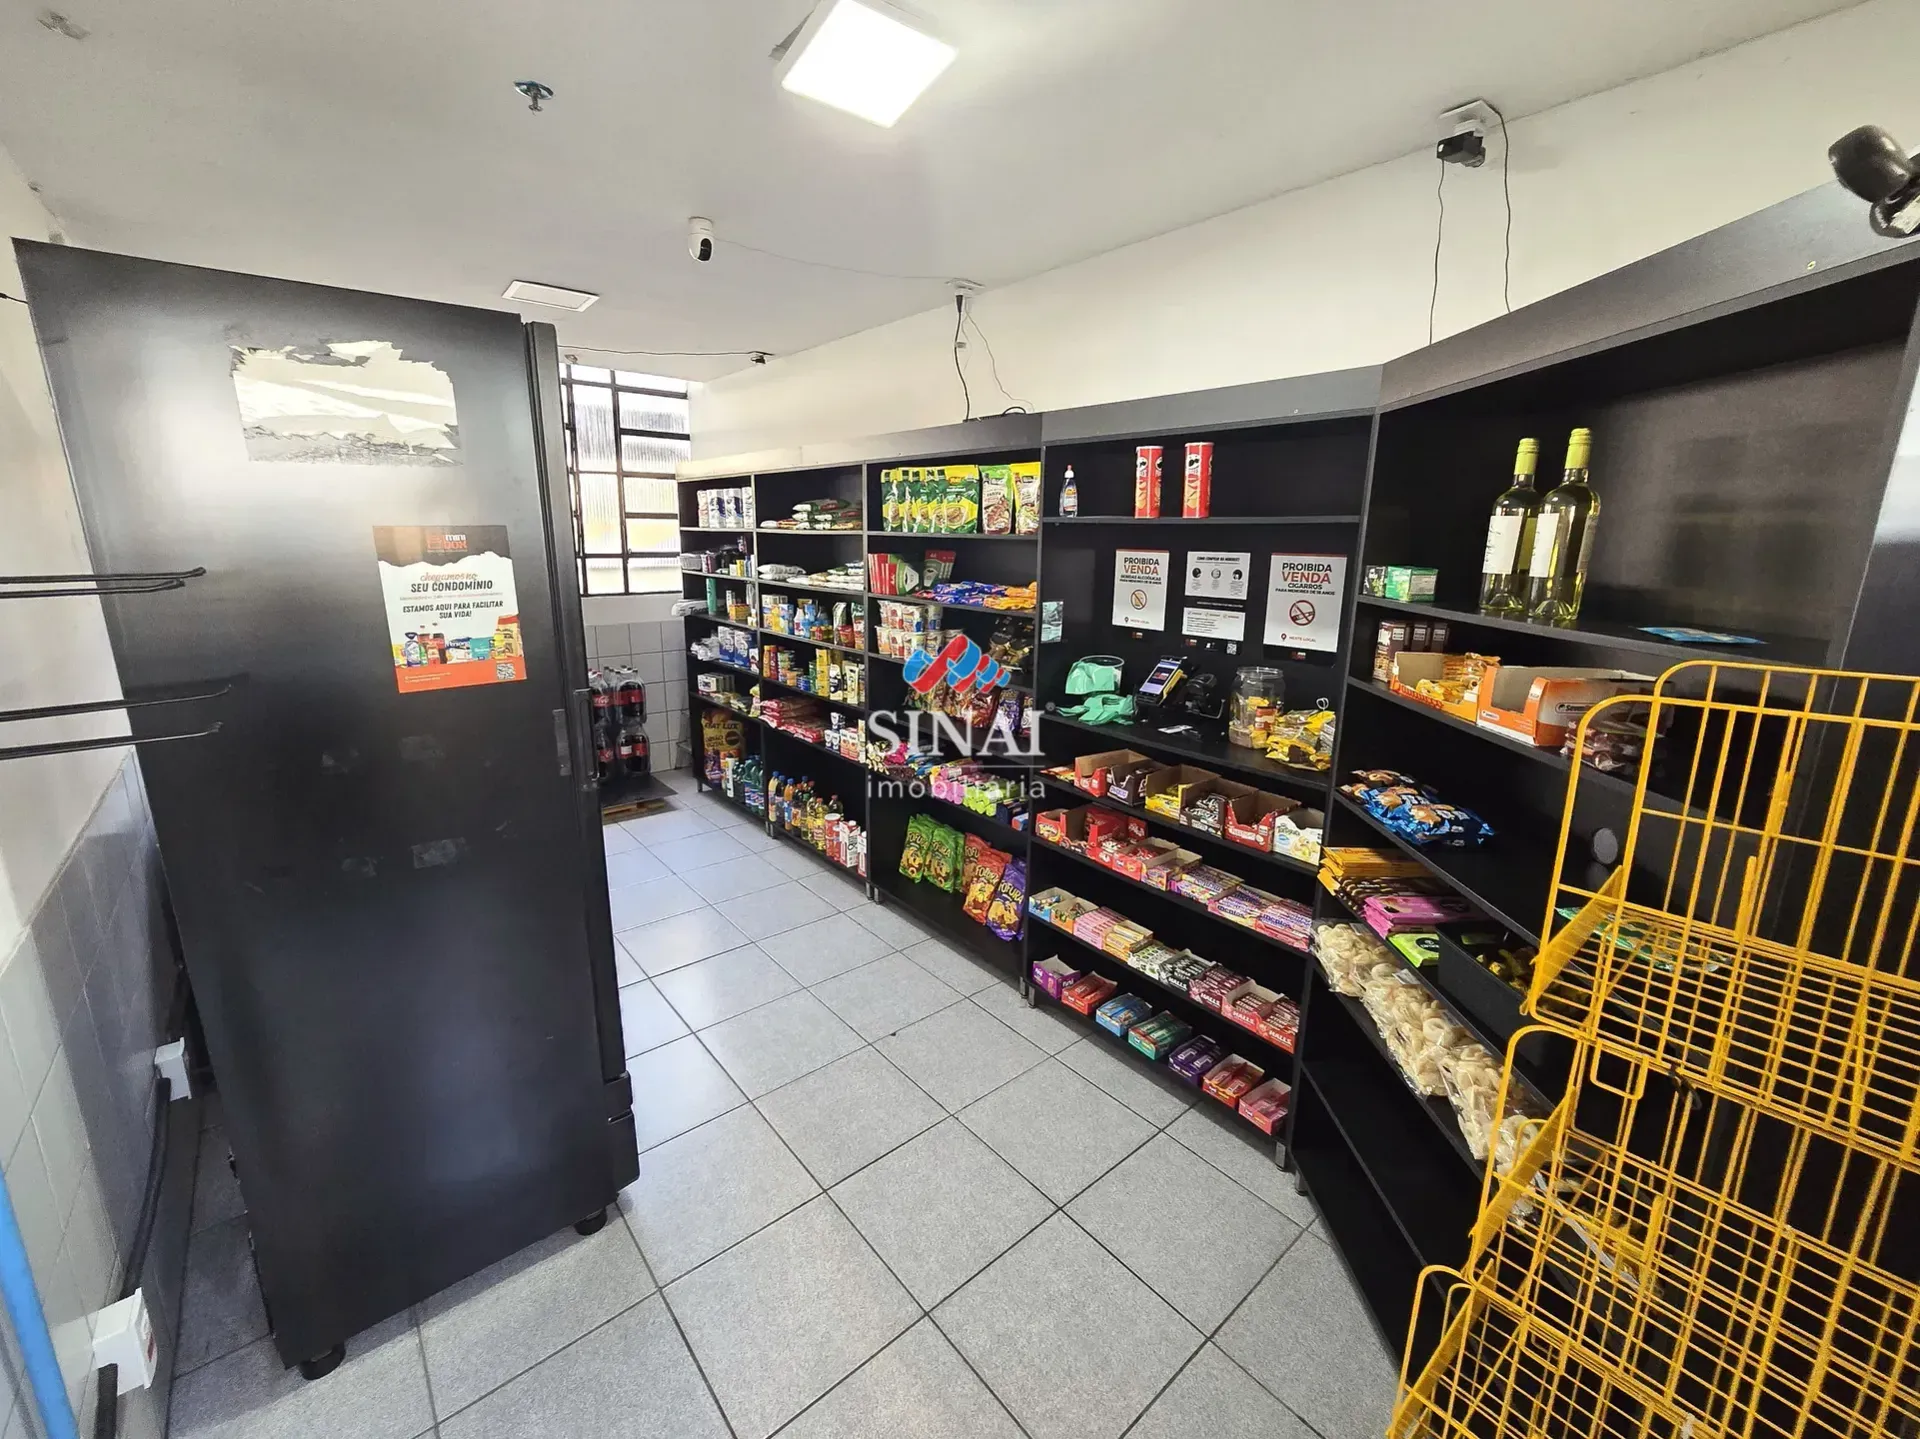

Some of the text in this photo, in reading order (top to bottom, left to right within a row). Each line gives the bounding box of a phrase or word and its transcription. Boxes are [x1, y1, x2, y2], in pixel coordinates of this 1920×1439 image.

[1124, 557, 1160, 566] PROIBIDA
[1282, 562, 1332, 572] PROIBIDA
[1124, 565, 1159, 575] VENDA
[1282, 572, 1331, 584] VENDA
[411, 580, 493, 593] SEU CONDOMÍNIO
[1288, 582, 1322, 590] CIGARROS
[403, 604, 434, 613] ESTAMOS
[454, 602, 471, 610] PARA
[472, 600, 504, 609] FACILITAR
[454, 610, 472, 618] VIDA!
[965, 846, 980, 858] FOFU
[999, 880, 1024, 904] FOFURA
[1168, 976, 1188, 990] HALLS
[1200, 993, 1220, 1006] HALLS
[1232, 1011, 1254, 1025] HALLS
[1269, 1030, 1292, 1045] HALLS
